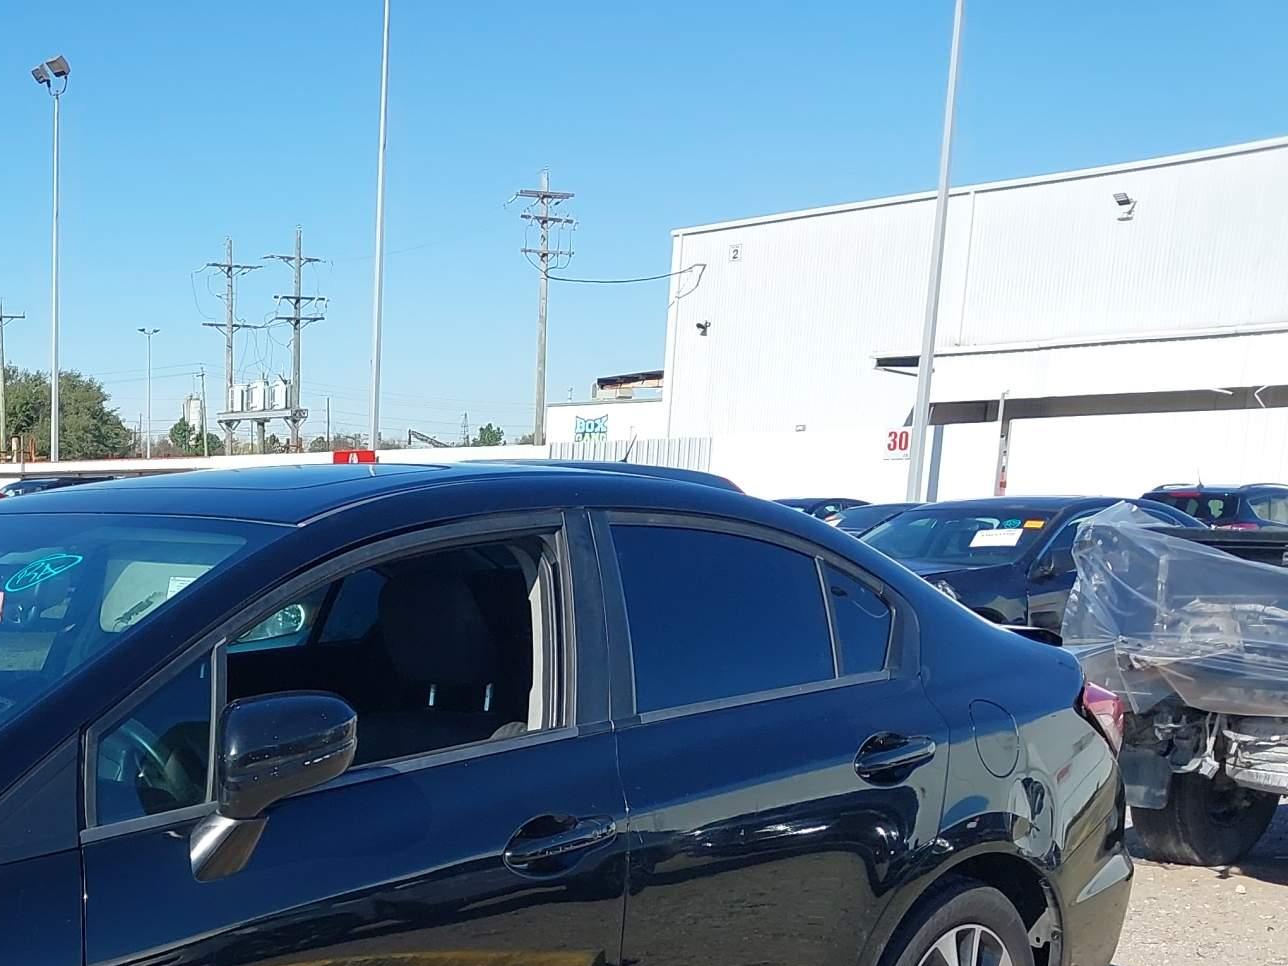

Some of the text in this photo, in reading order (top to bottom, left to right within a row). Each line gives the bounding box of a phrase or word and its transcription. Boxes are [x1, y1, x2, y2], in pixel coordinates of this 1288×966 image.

[732, 249, 739, 259] 2
[575, 414, 608, 433] BOX
[887, 431, 909, 451] 30
